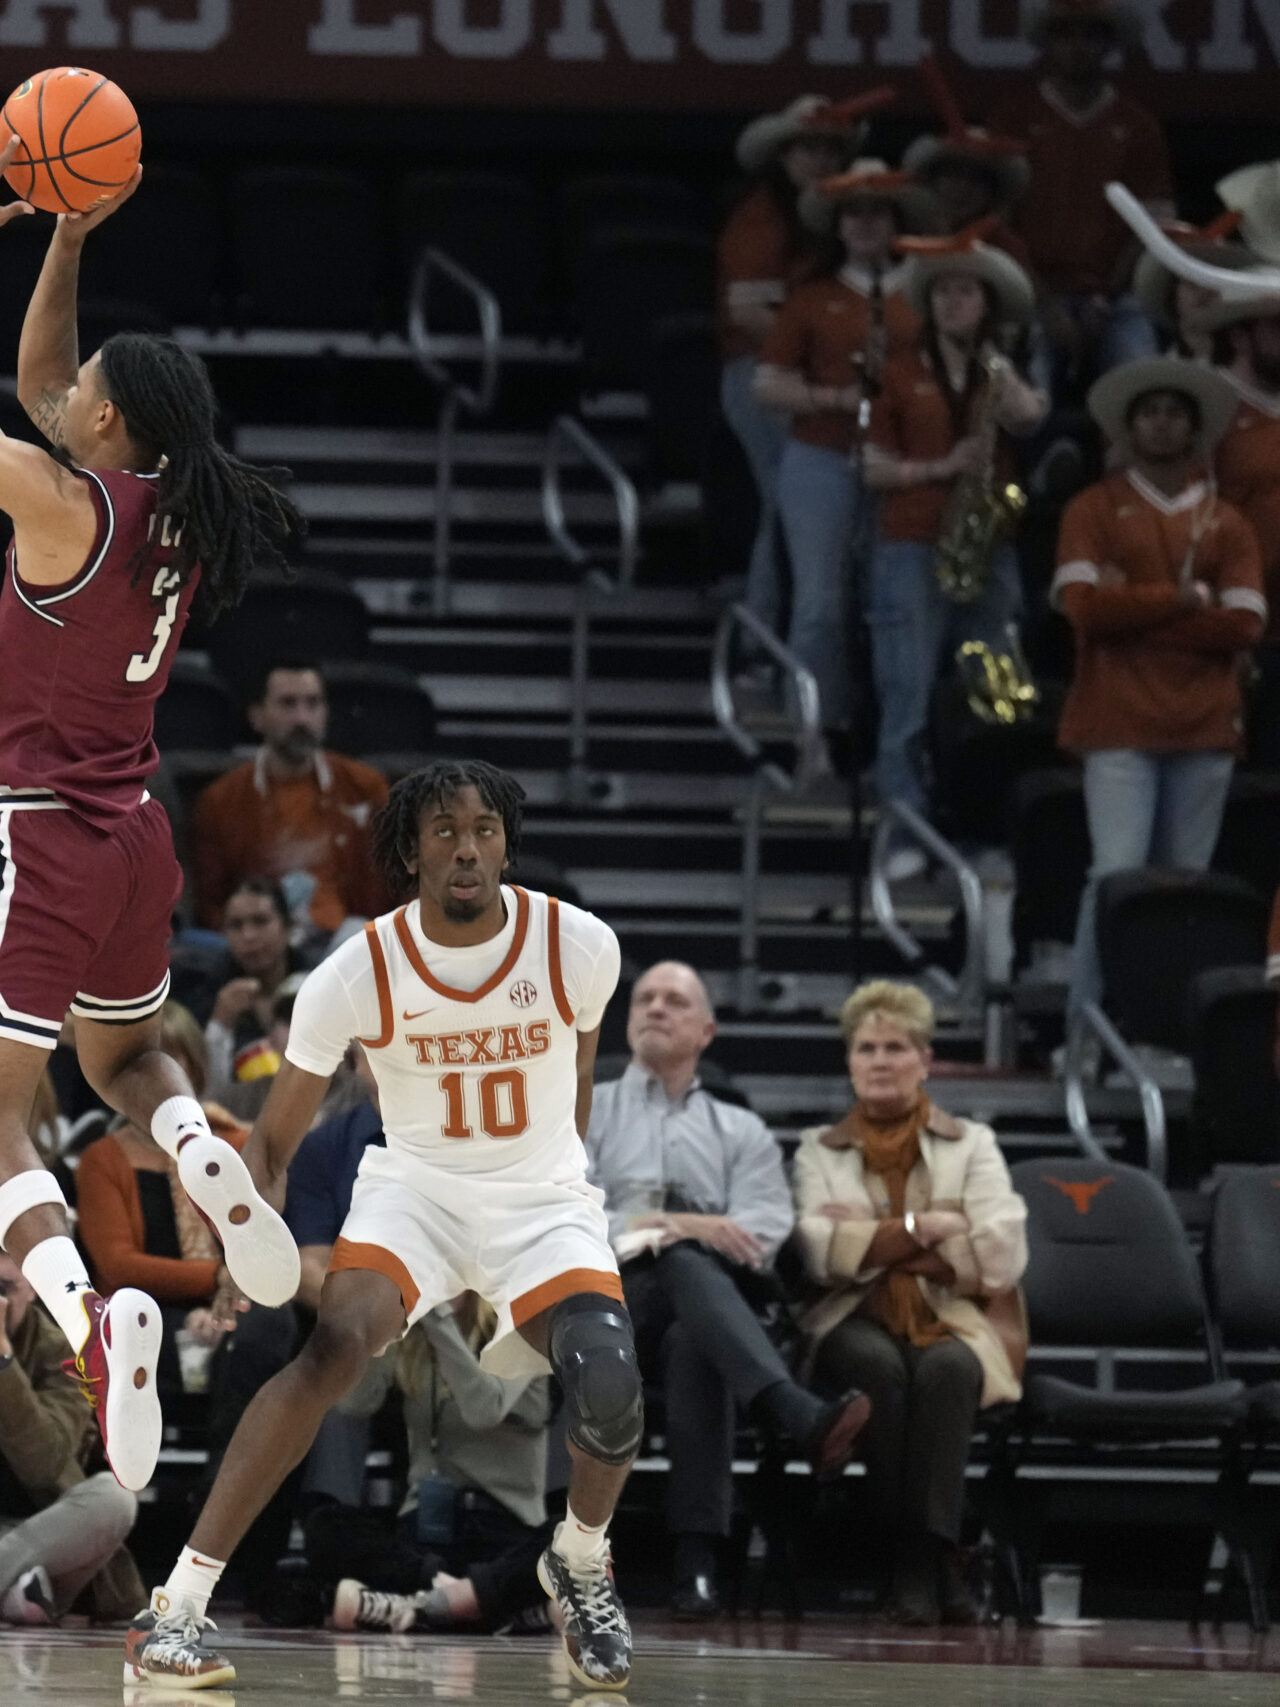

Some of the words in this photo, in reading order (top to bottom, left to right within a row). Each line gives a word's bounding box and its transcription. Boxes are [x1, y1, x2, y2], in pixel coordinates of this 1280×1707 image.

[125, 566, 181, 682] 3
[405, 1018, 552, 1066] TEXAS
[438, 1066, 531, 1140] 10
